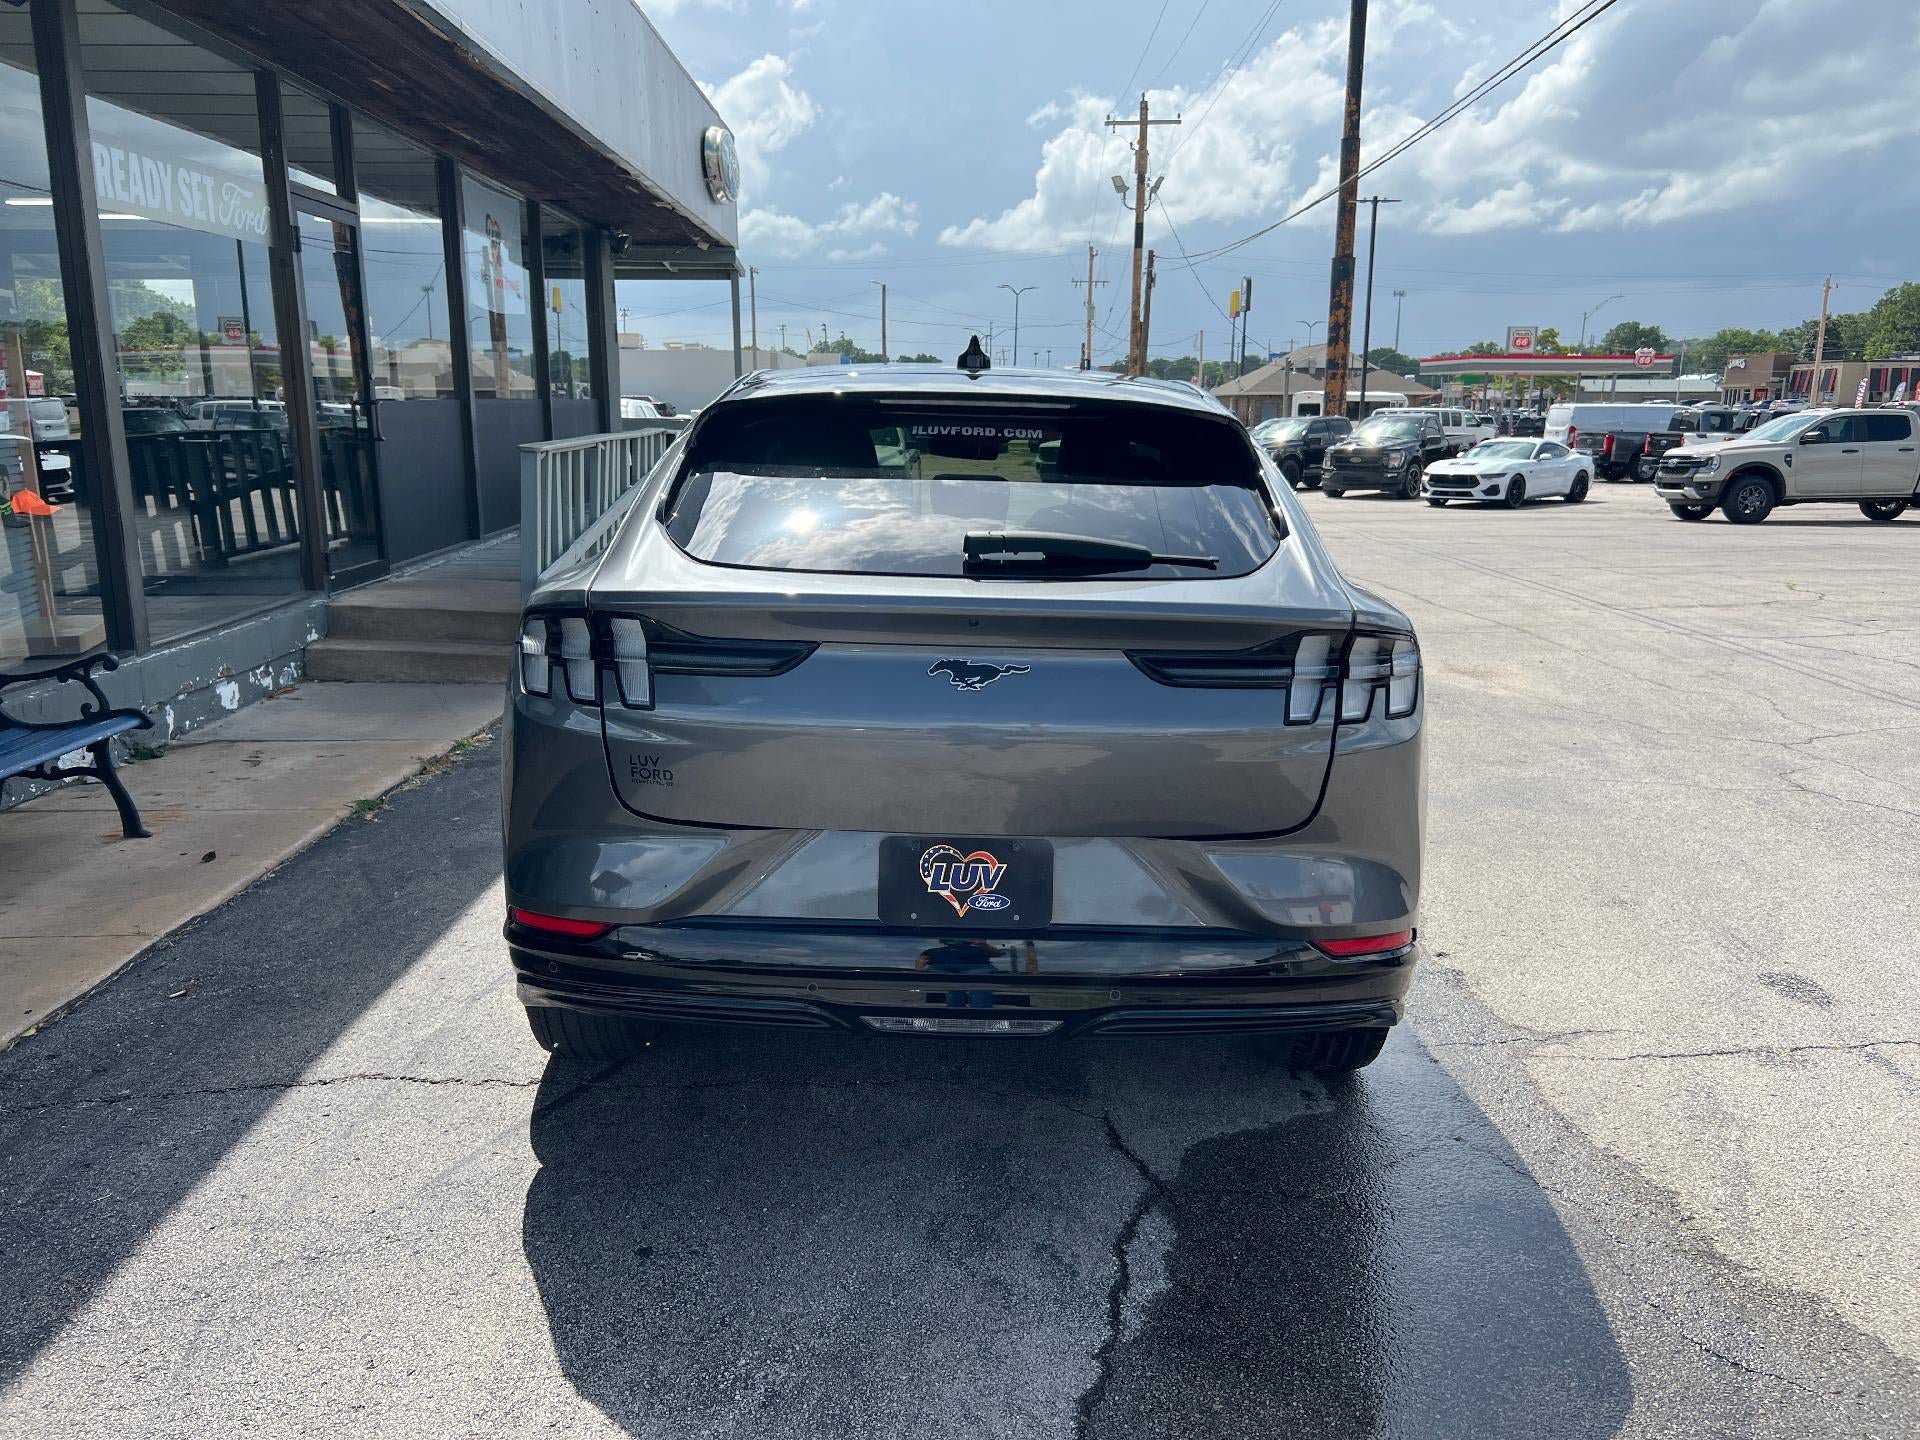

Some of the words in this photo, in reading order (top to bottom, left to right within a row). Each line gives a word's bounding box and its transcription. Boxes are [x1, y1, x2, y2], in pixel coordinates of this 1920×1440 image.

[91, 142, 172, 212] READY
[177, 168, 217, 224] SET
[218, 182, 270, 235] Ford
[1515, 337, 1529, 346] 66
[1638, 356, 1651, 364] 66
[630, 754, 660, 767] LUV
[630, 767, 674, 781] FORD
[927, 863, 1008, 892] LUV
[975, 895, 1003, 909] Ford
